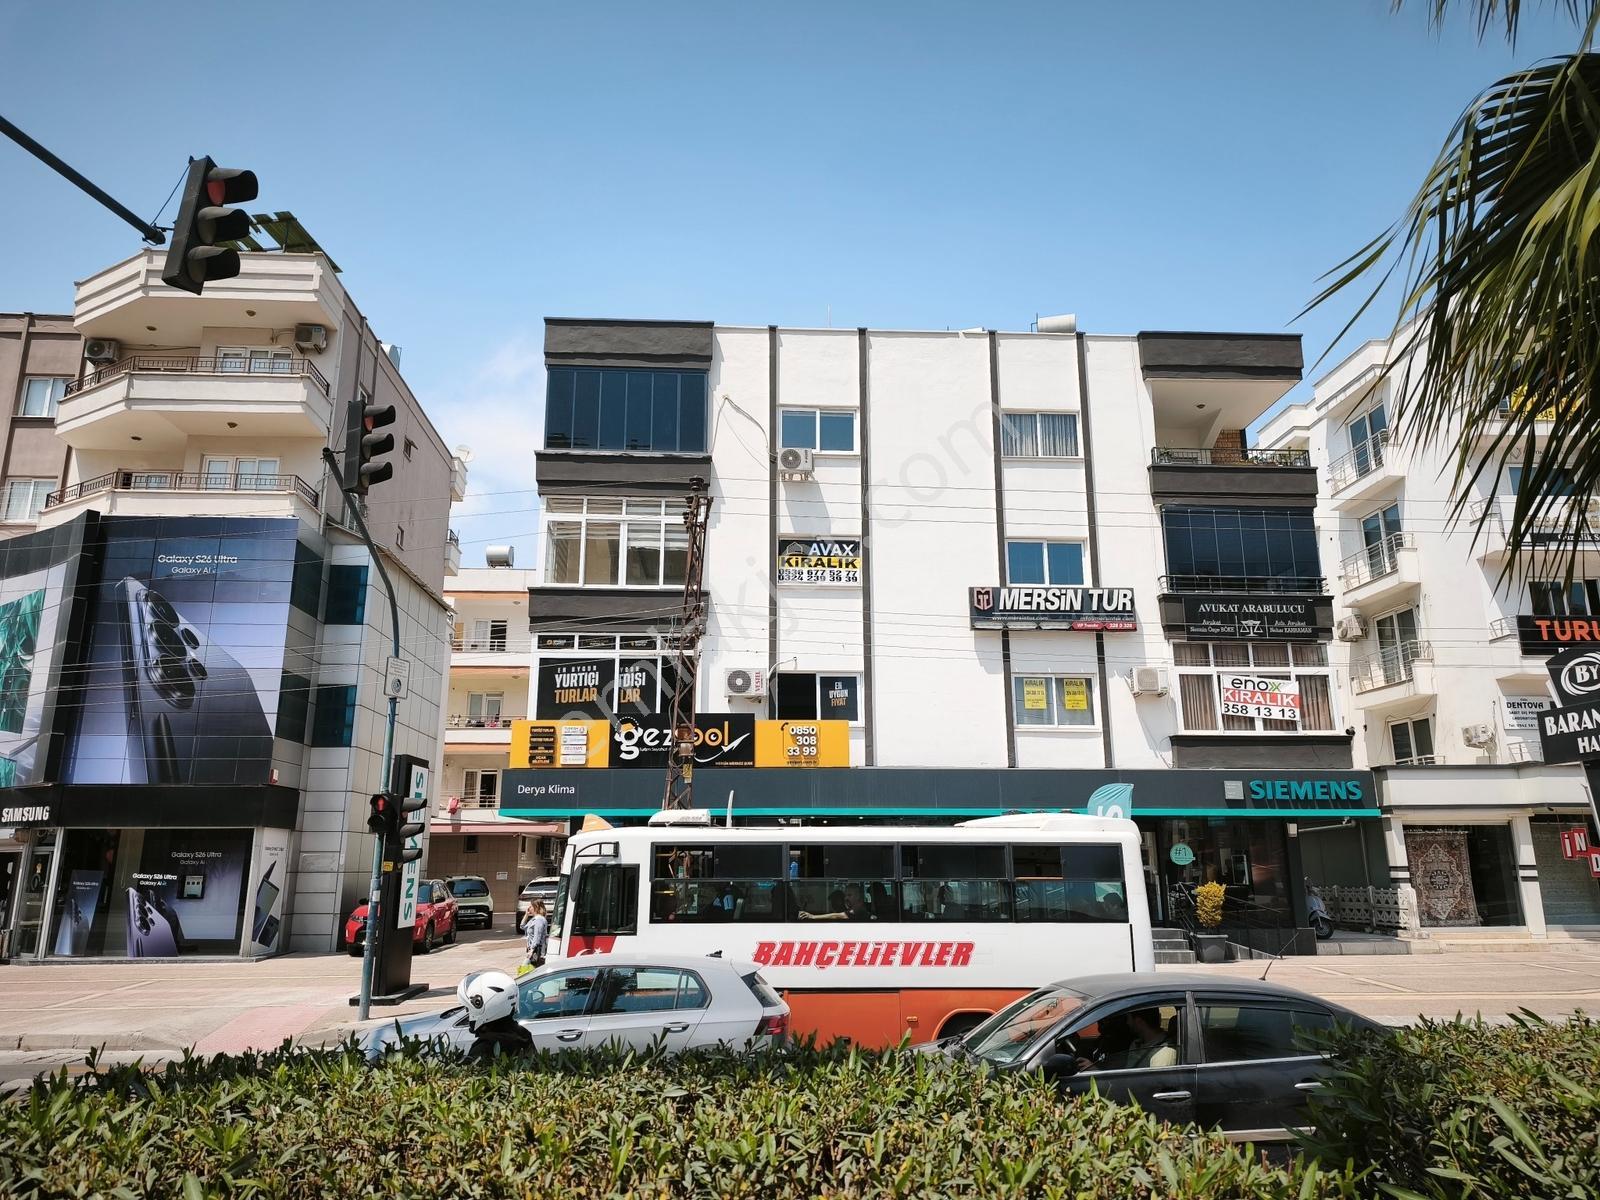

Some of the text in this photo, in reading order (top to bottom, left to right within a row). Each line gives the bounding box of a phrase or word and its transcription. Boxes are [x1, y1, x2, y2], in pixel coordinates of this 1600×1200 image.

[808, 543, 855, 556] AVAX
[157, 554, 238, 565] Galaxy S26 Ultra
[171, 566, 201, 575] Galaxy
[1088, 589, 1133, 611] TUR
[1198, 604, 1305, 614] AVUKAT ARABULUCU
[554, 688, 598, 704] TURLAR
[1506, 701, 1544, 709] DENTOVA
[1254, 706, 1272, 717] 13
[1279, 708, 1297, 719] 13
[789, 725, 817, 735] 0850
[796, 735, 817, 745] 308
[787, 746, 817, 756] 33 99
[517, 784, 575, 796] Derya Klima
[1249, 779, 1363, 800] SIEMENS
[1, 806, 50, 822] SAMSUNG
[171, 851, 194, 859] Galaxy
